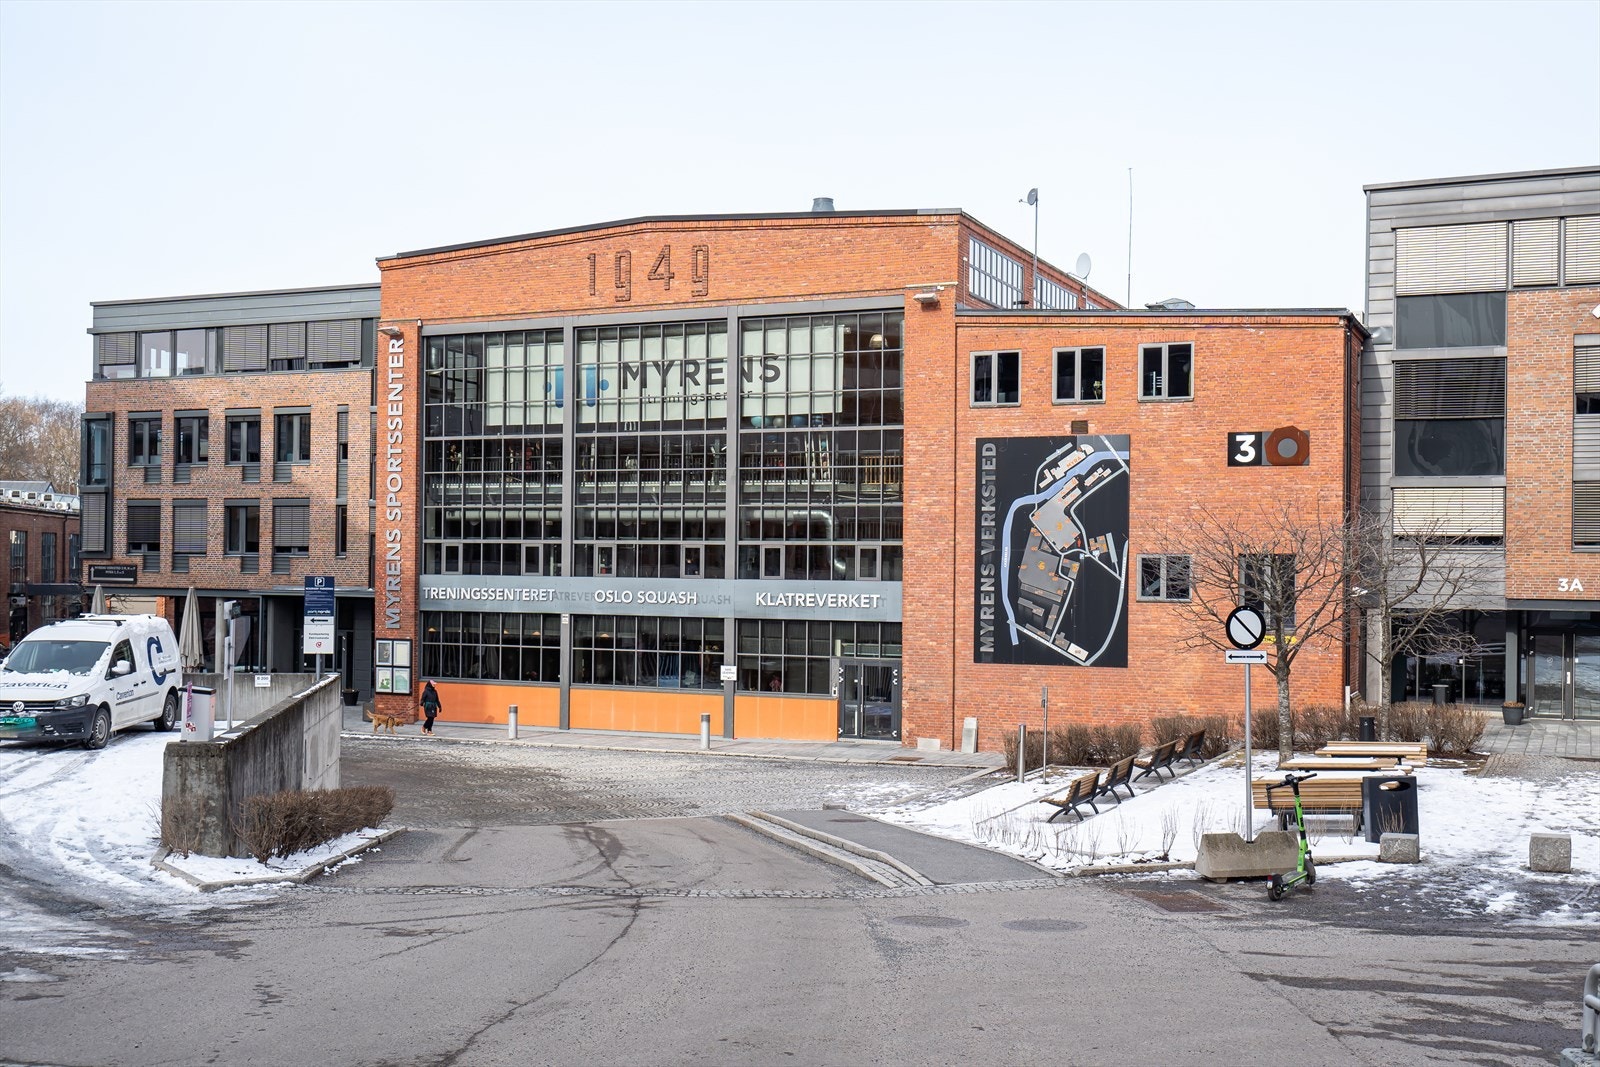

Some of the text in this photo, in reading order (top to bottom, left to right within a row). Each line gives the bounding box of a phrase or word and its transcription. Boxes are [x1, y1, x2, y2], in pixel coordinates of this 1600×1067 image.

[587, 245, 709, 302] 1949
[622, 353, 781, 389] MYRENS
[1234, 434, 1256, 463] 3
[386, 338, 404, 629] MYRENS SPORTSSENTER
[980, 442, 997, 653] MYRENS VERKSTED
[423, 587, 555, 601] TRENINGSSENTERET
[594, 589, 698, 605] OSLO SQUASH
[1558, 578, 1584, 591] 3A
[755, 592, 880, 608] KLATREVERKET
